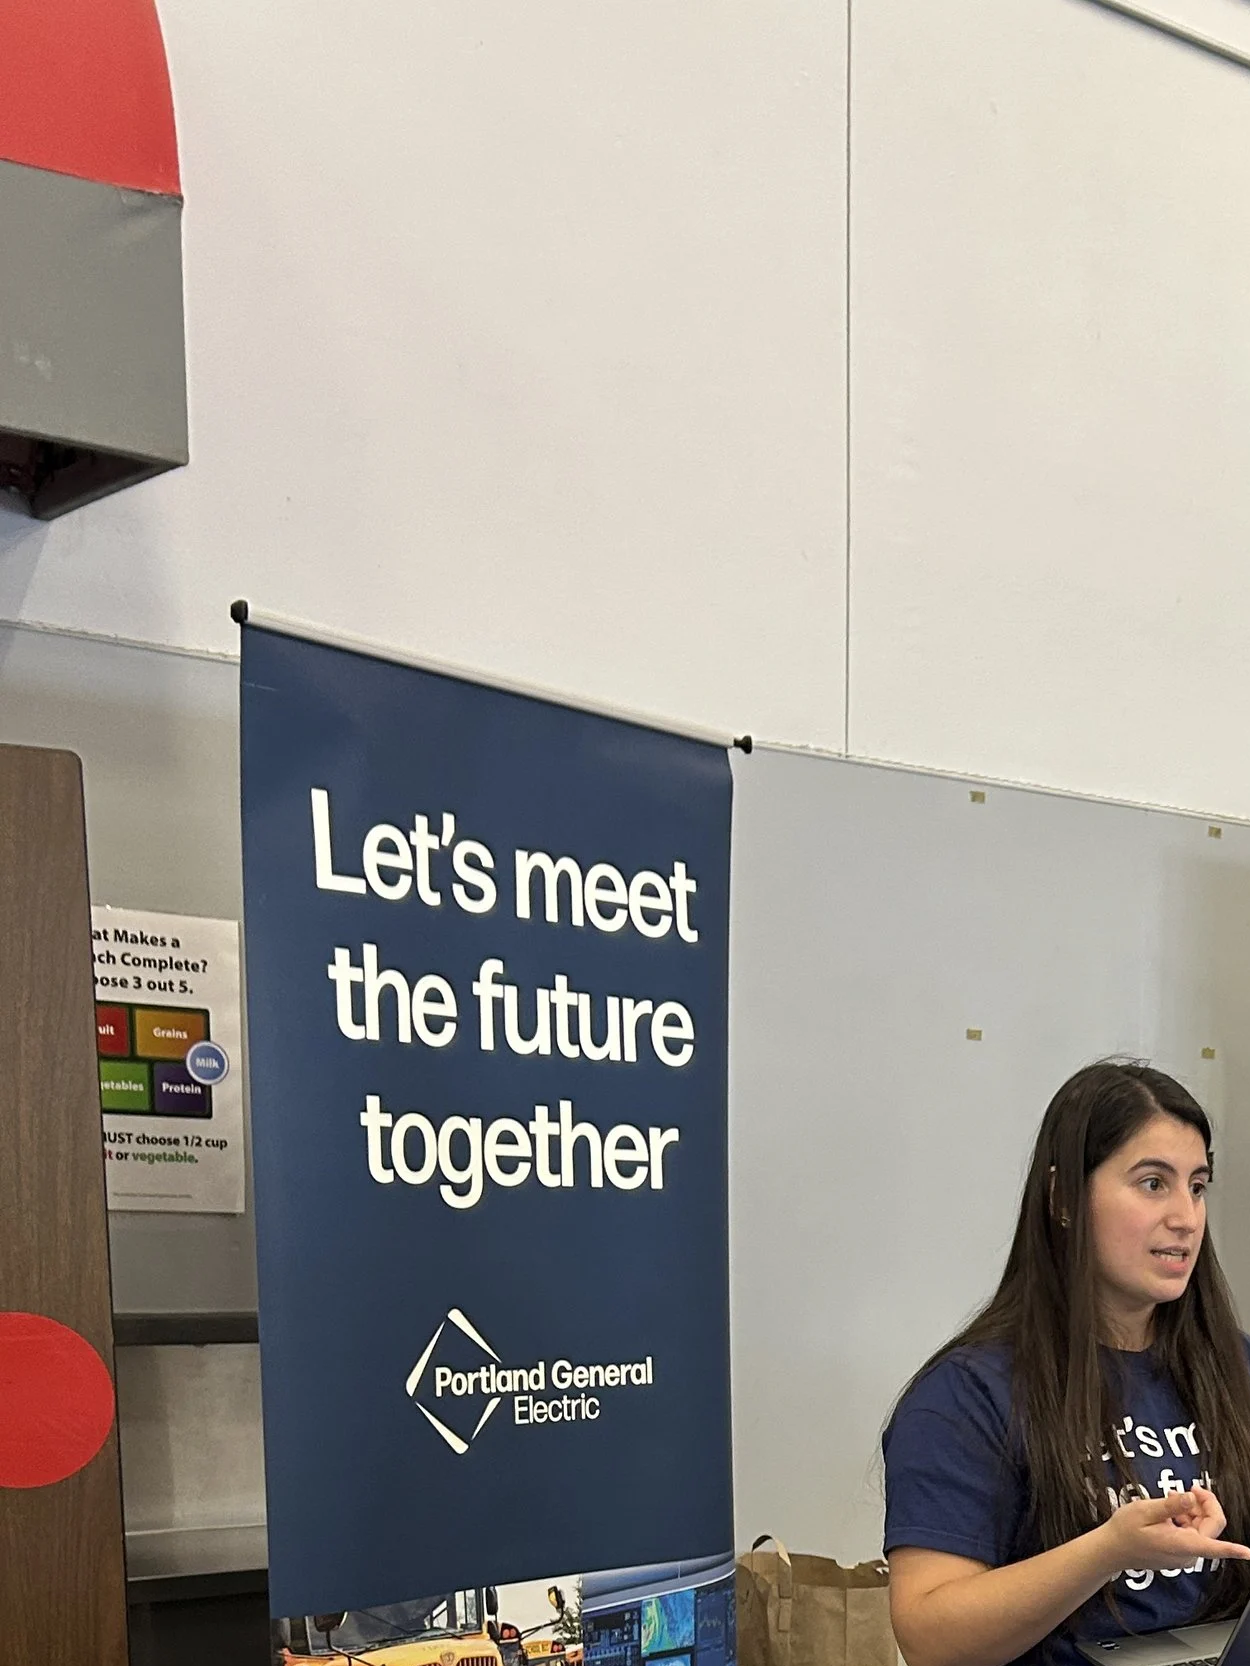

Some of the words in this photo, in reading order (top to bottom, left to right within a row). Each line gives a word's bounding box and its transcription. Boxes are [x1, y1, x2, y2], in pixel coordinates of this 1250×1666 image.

[310, 787, 497, 916] Let's
[514, 847, 698, 943] meet
[92, 929, 109, 942] at
[114, 928, 167, 947] Makes
[170, 936, 181, 948] a
[120, 953, 208, 973] Complete?
[93, 977, 129, 989] oose
[132, 976, 142, 989] 3
[147, 980, 174, 993] out
[178, 980, 194, 995] 5.
[327, 942, 457, 1048] the
[472, 957, 695, 1068] future
[98, 1024, 115, 1037] uit
[152, 1027, 188, 1040] Grains
[195, 1057, 220, 1070] Milk
[162, 1082, 202, 1095] Protein
[136, 1134, 180, 1148] choose
[183, 1135, 202, 1149] 1/2
[205, 1138, 229, 1152] cup
[360, 1094, 680, 1210] together
[116, 1152, 129, 1162] or
[132, 1151, 199, 1165] vegetable.
[435, 1361, 546, 1398] Portland
[551, 1356, 653, 1390] General
[514, 1393, 601, 1425] Electric
